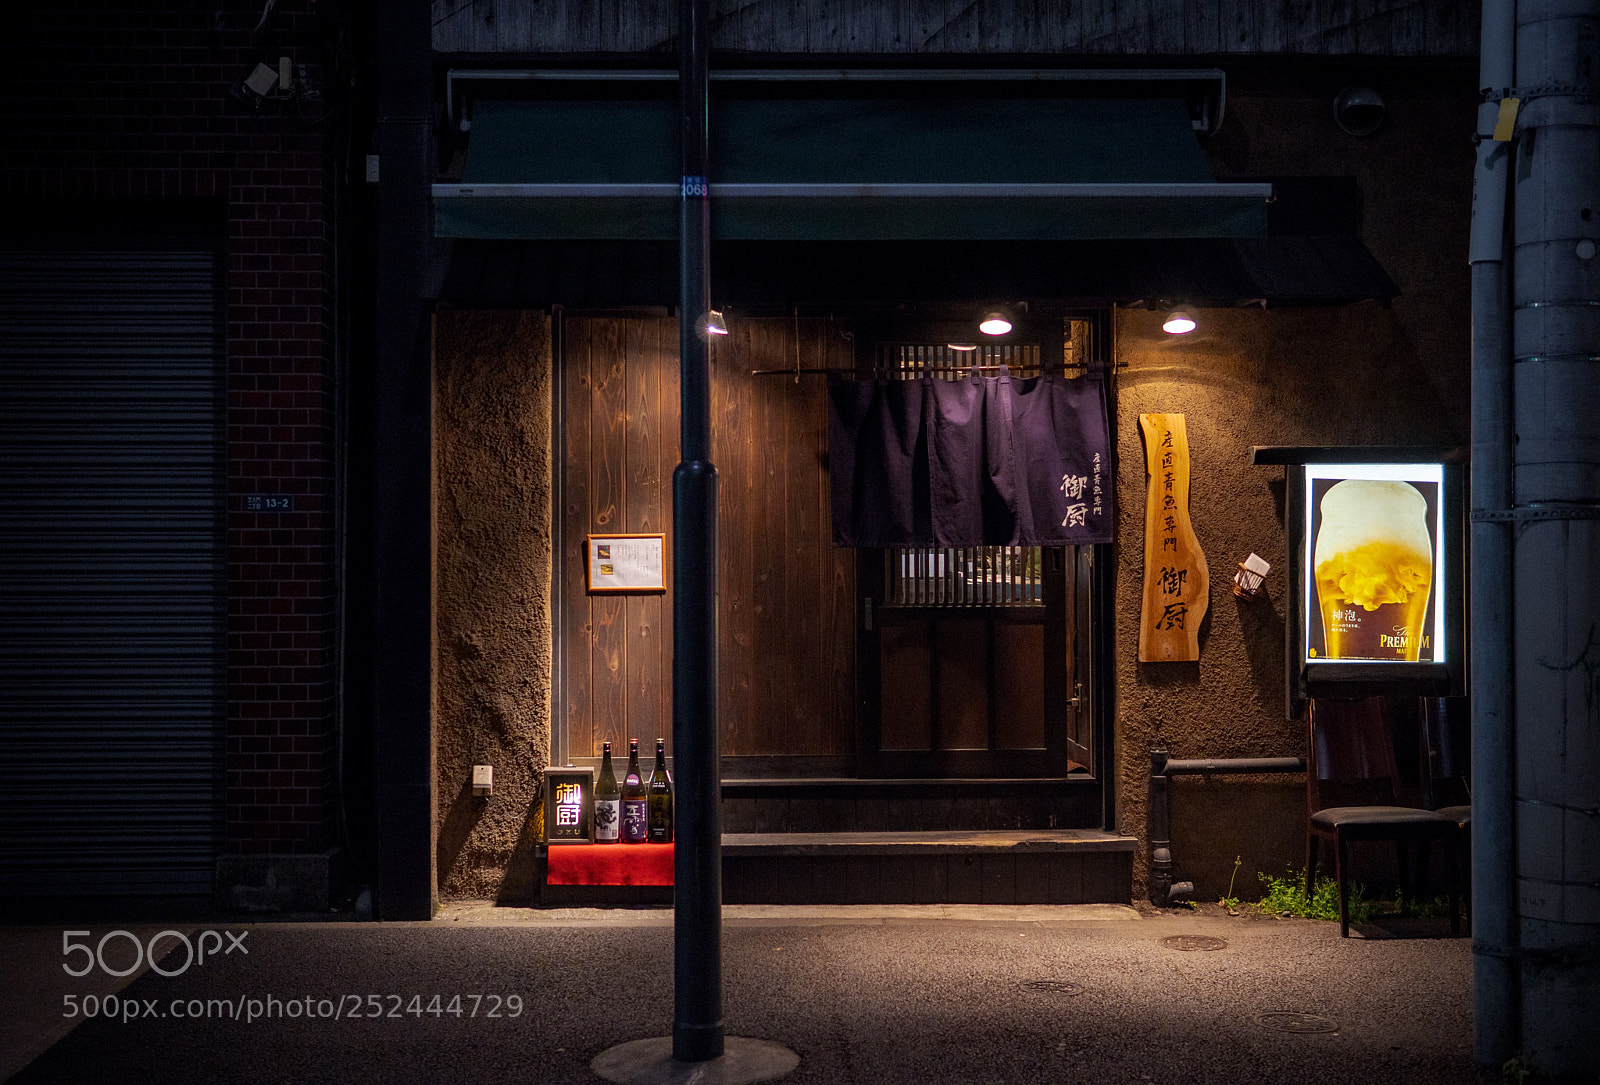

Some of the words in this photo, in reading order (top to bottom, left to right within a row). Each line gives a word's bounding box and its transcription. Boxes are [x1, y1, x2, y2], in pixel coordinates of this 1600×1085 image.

[265, 498, 289, 508] 13-2
[1060, 474, 1089, 528] 御厨
[1161, 430, 1178, 553] 産直青魚専門
[1155, 566, 1189, 631] 御厨
[556, 782, 581, 826] 御厨
